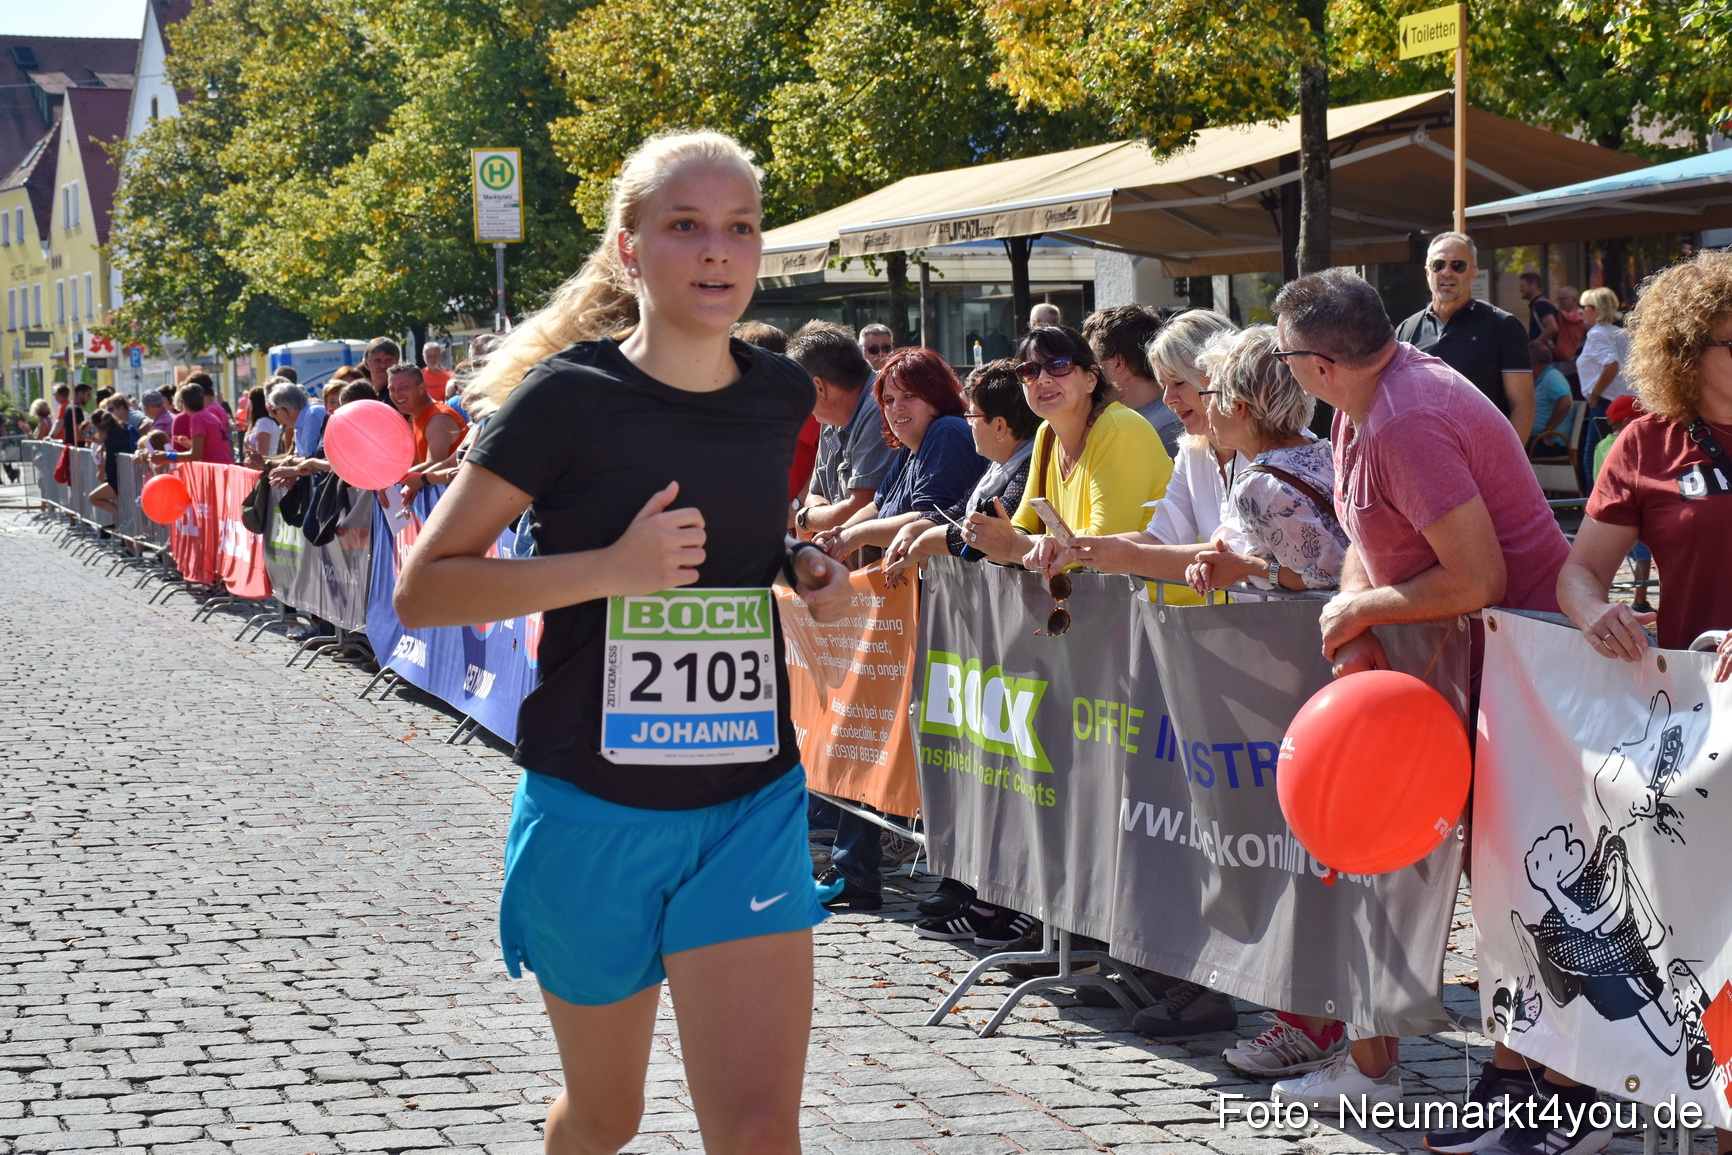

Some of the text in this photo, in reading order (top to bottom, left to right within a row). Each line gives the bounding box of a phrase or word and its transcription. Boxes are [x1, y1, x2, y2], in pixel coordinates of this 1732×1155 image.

[1410, 22, 1456, 45] Toiletten
[488, 163, 505, 182] H
[627, 600, 761, 630] BOCK
[629, 650, 762, 703] 2103
[846, 703, 863, 717] sich
[863, 703, 878, 720] bei
[630, 719, 760, 744] JOHANNA
[839, 724, 888, 743] codeclinic.de
[835, 743, 859, 760] 09181
